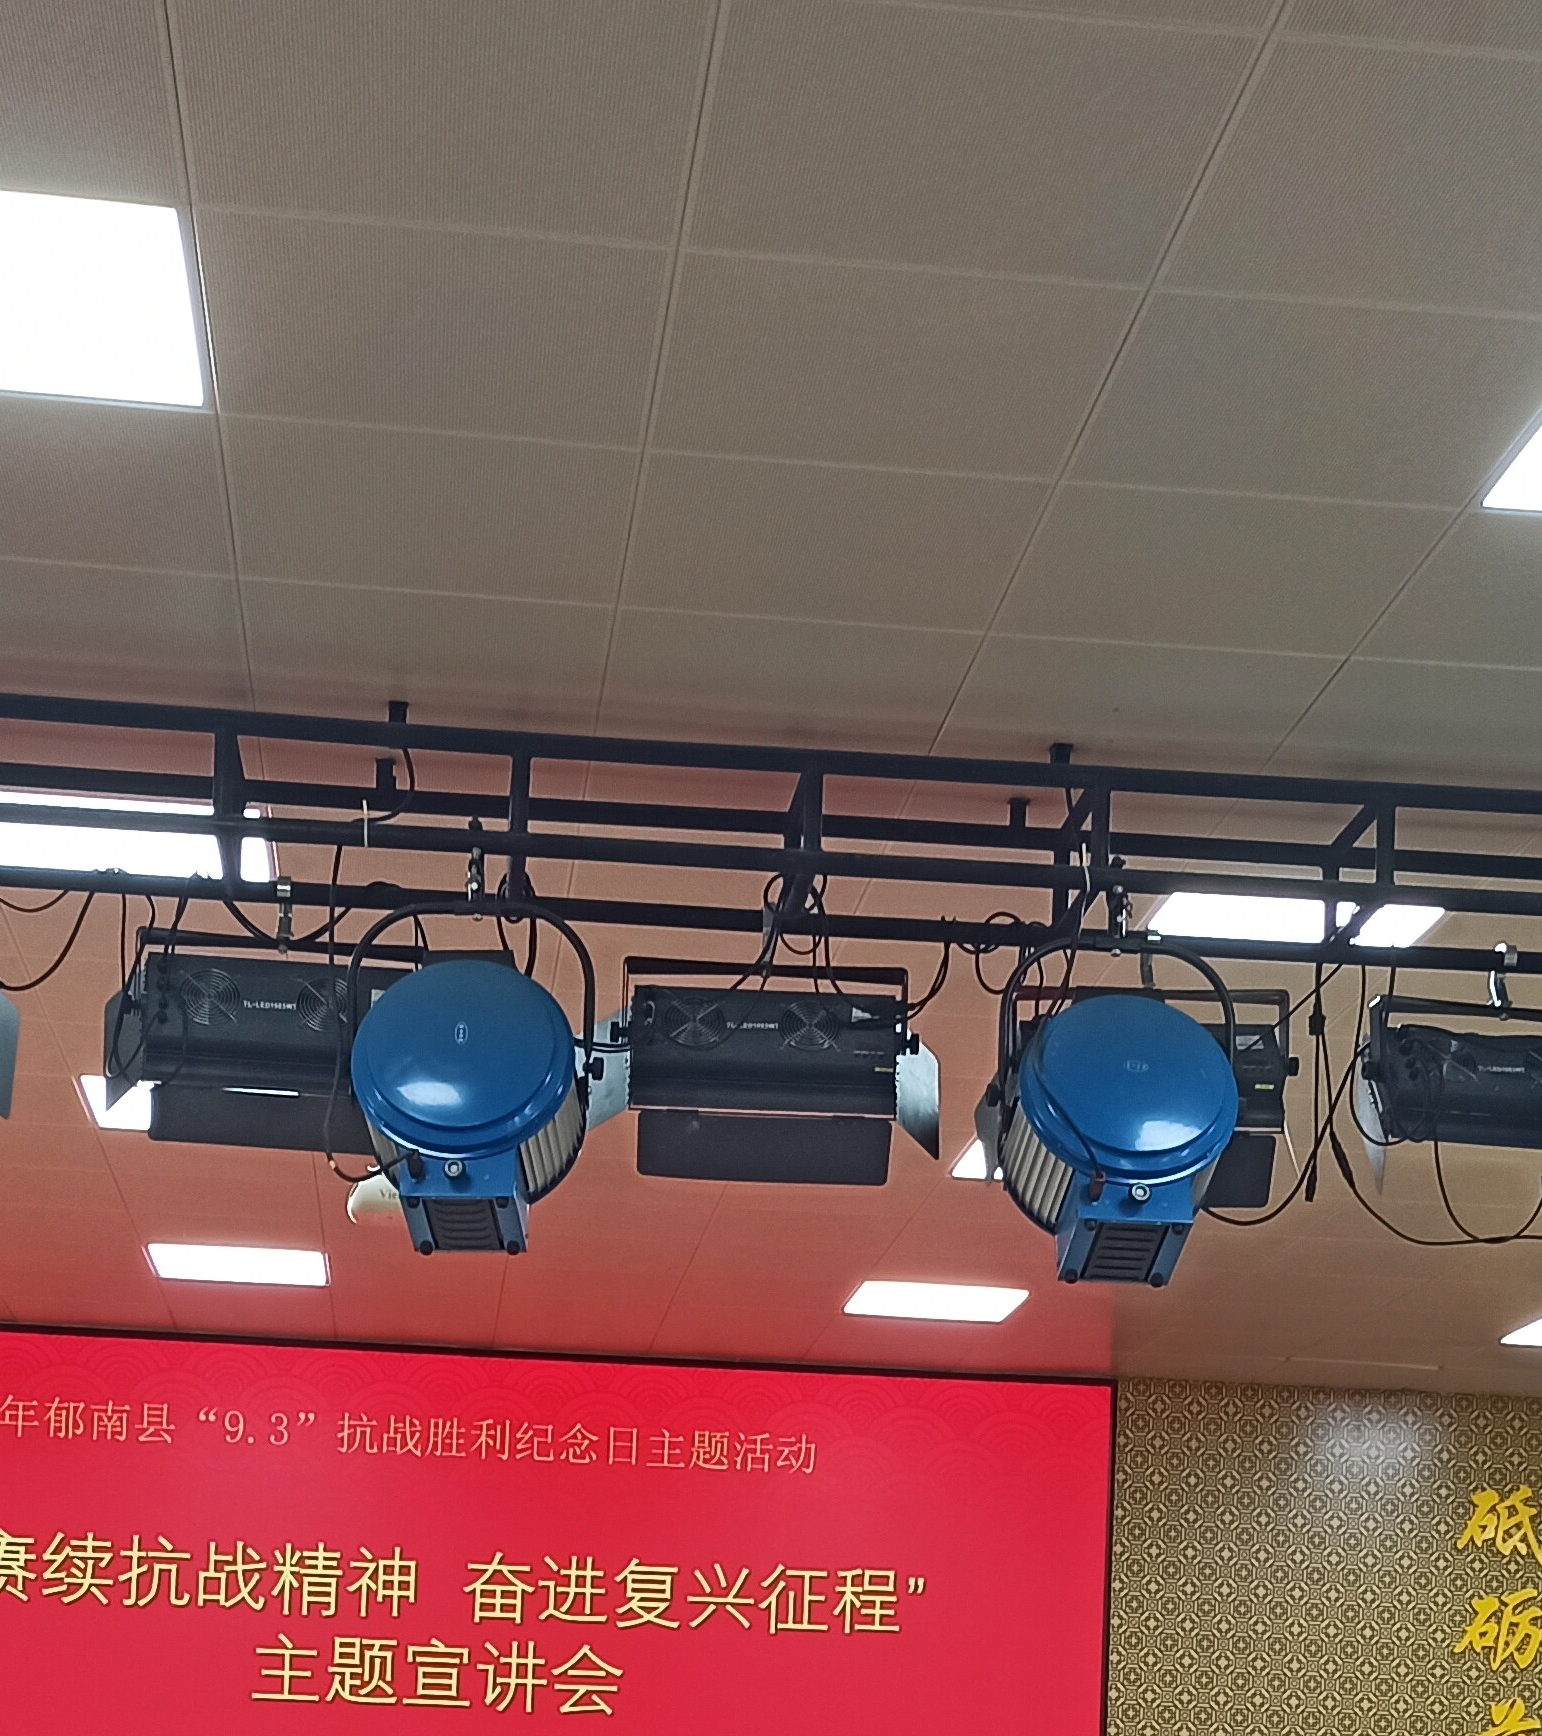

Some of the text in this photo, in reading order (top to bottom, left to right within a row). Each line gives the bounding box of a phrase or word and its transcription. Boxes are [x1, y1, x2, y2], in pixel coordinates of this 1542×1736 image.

[462, 1551, 927, 1636] 奋进复兴征程”
[250, 1633, 624, 1717] 主题宣讲会
